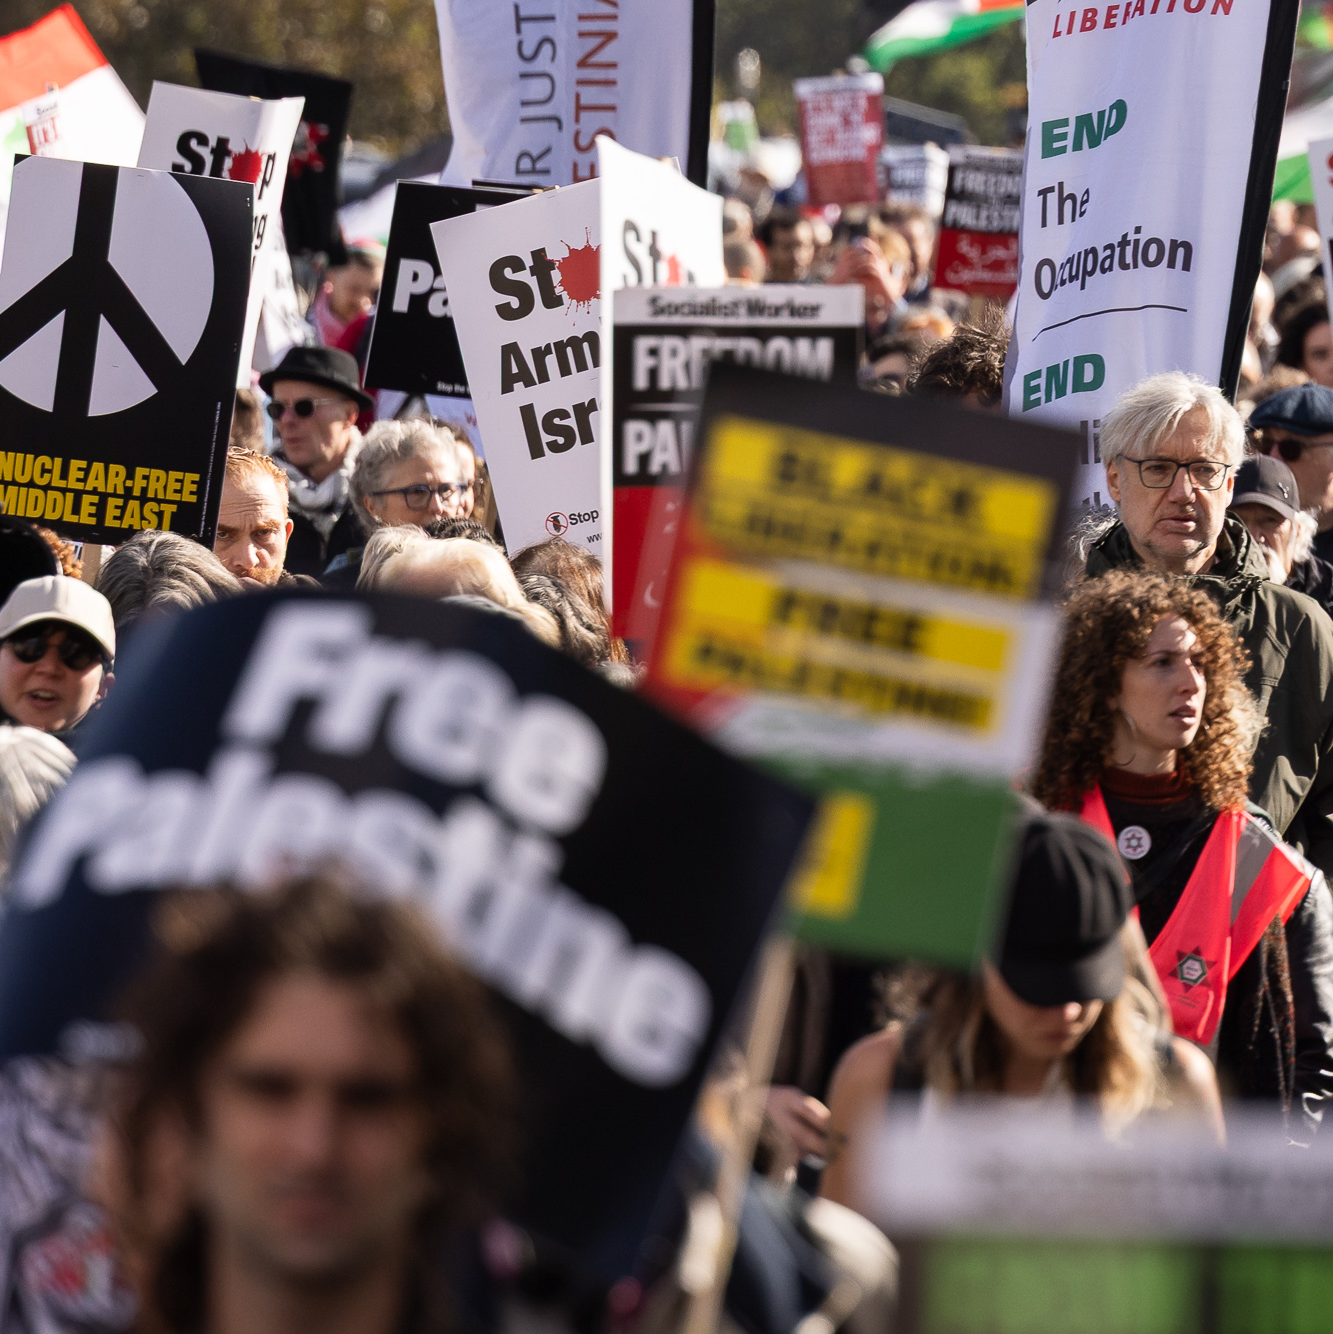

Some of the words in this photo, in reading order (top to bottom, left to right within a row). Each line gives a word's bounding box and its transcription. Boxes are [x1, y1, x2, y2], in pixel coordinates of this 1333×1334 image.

[1041, 98, 1128, 159] END
[1037, 181, 1090, 229] The
[1034, 225, 1193, 300] Occupation
[501, 330, 600, 395] Arm
[1022, 353, 1105, 412] END
[519, 397, 599, 461] Isr
[0, 451, 200, 502] NUCLEAR-FREE
[0, 485, 99, 526] MIDDLE
[104, 497, 178, 531] EAST
[568, 509, 599, 526] Stop
[222, 598, 608, 834] Free
